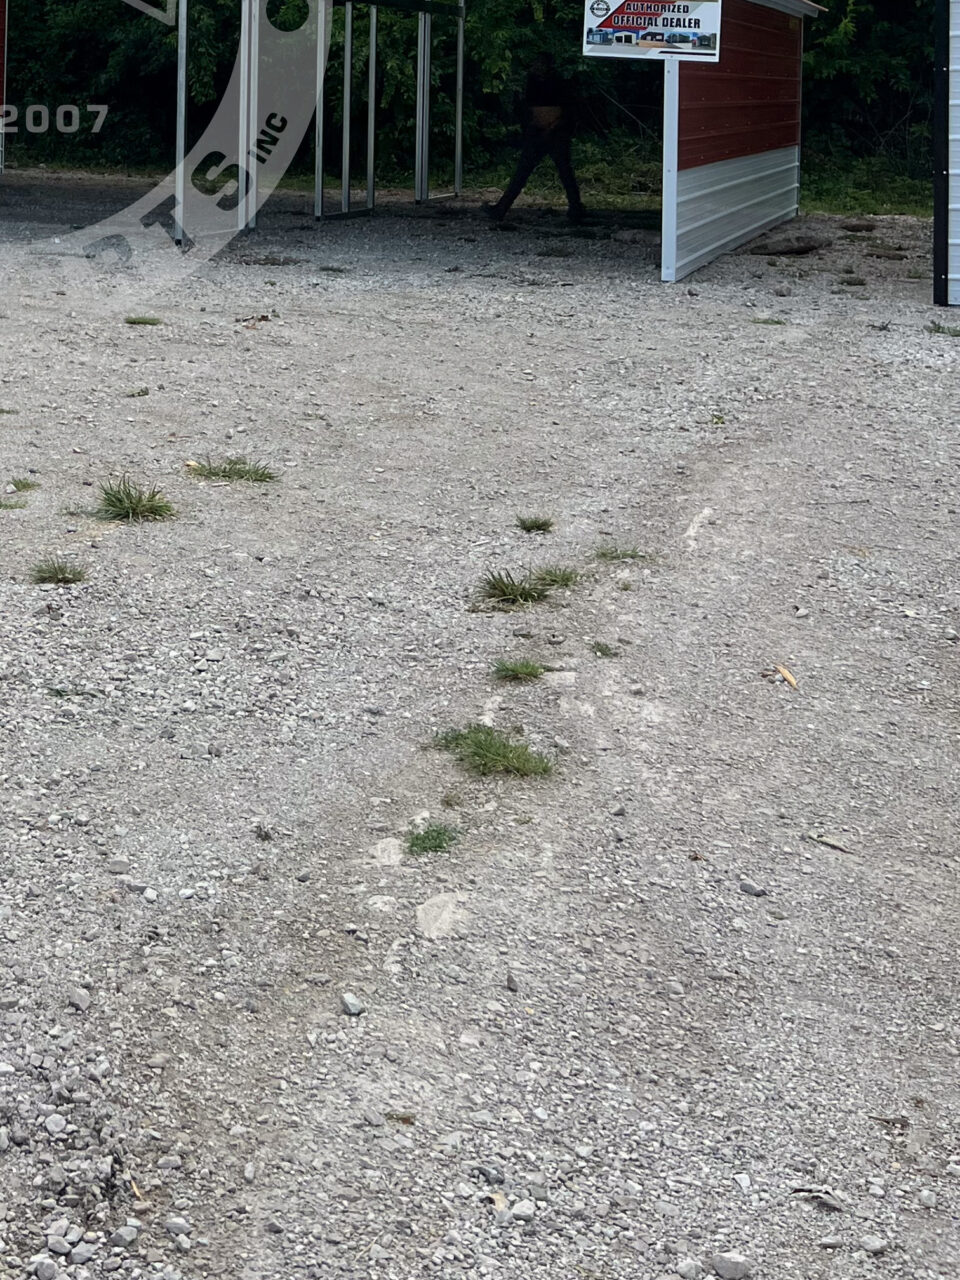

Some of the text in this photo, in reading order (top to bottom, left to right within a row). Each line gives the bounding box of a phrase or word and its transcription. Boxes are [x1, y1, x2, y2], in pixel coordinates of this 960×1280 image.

[625, 1, 690, 14] AUTHORIZED
[613, 14, 701, 29] OFFICIAL DEALER
